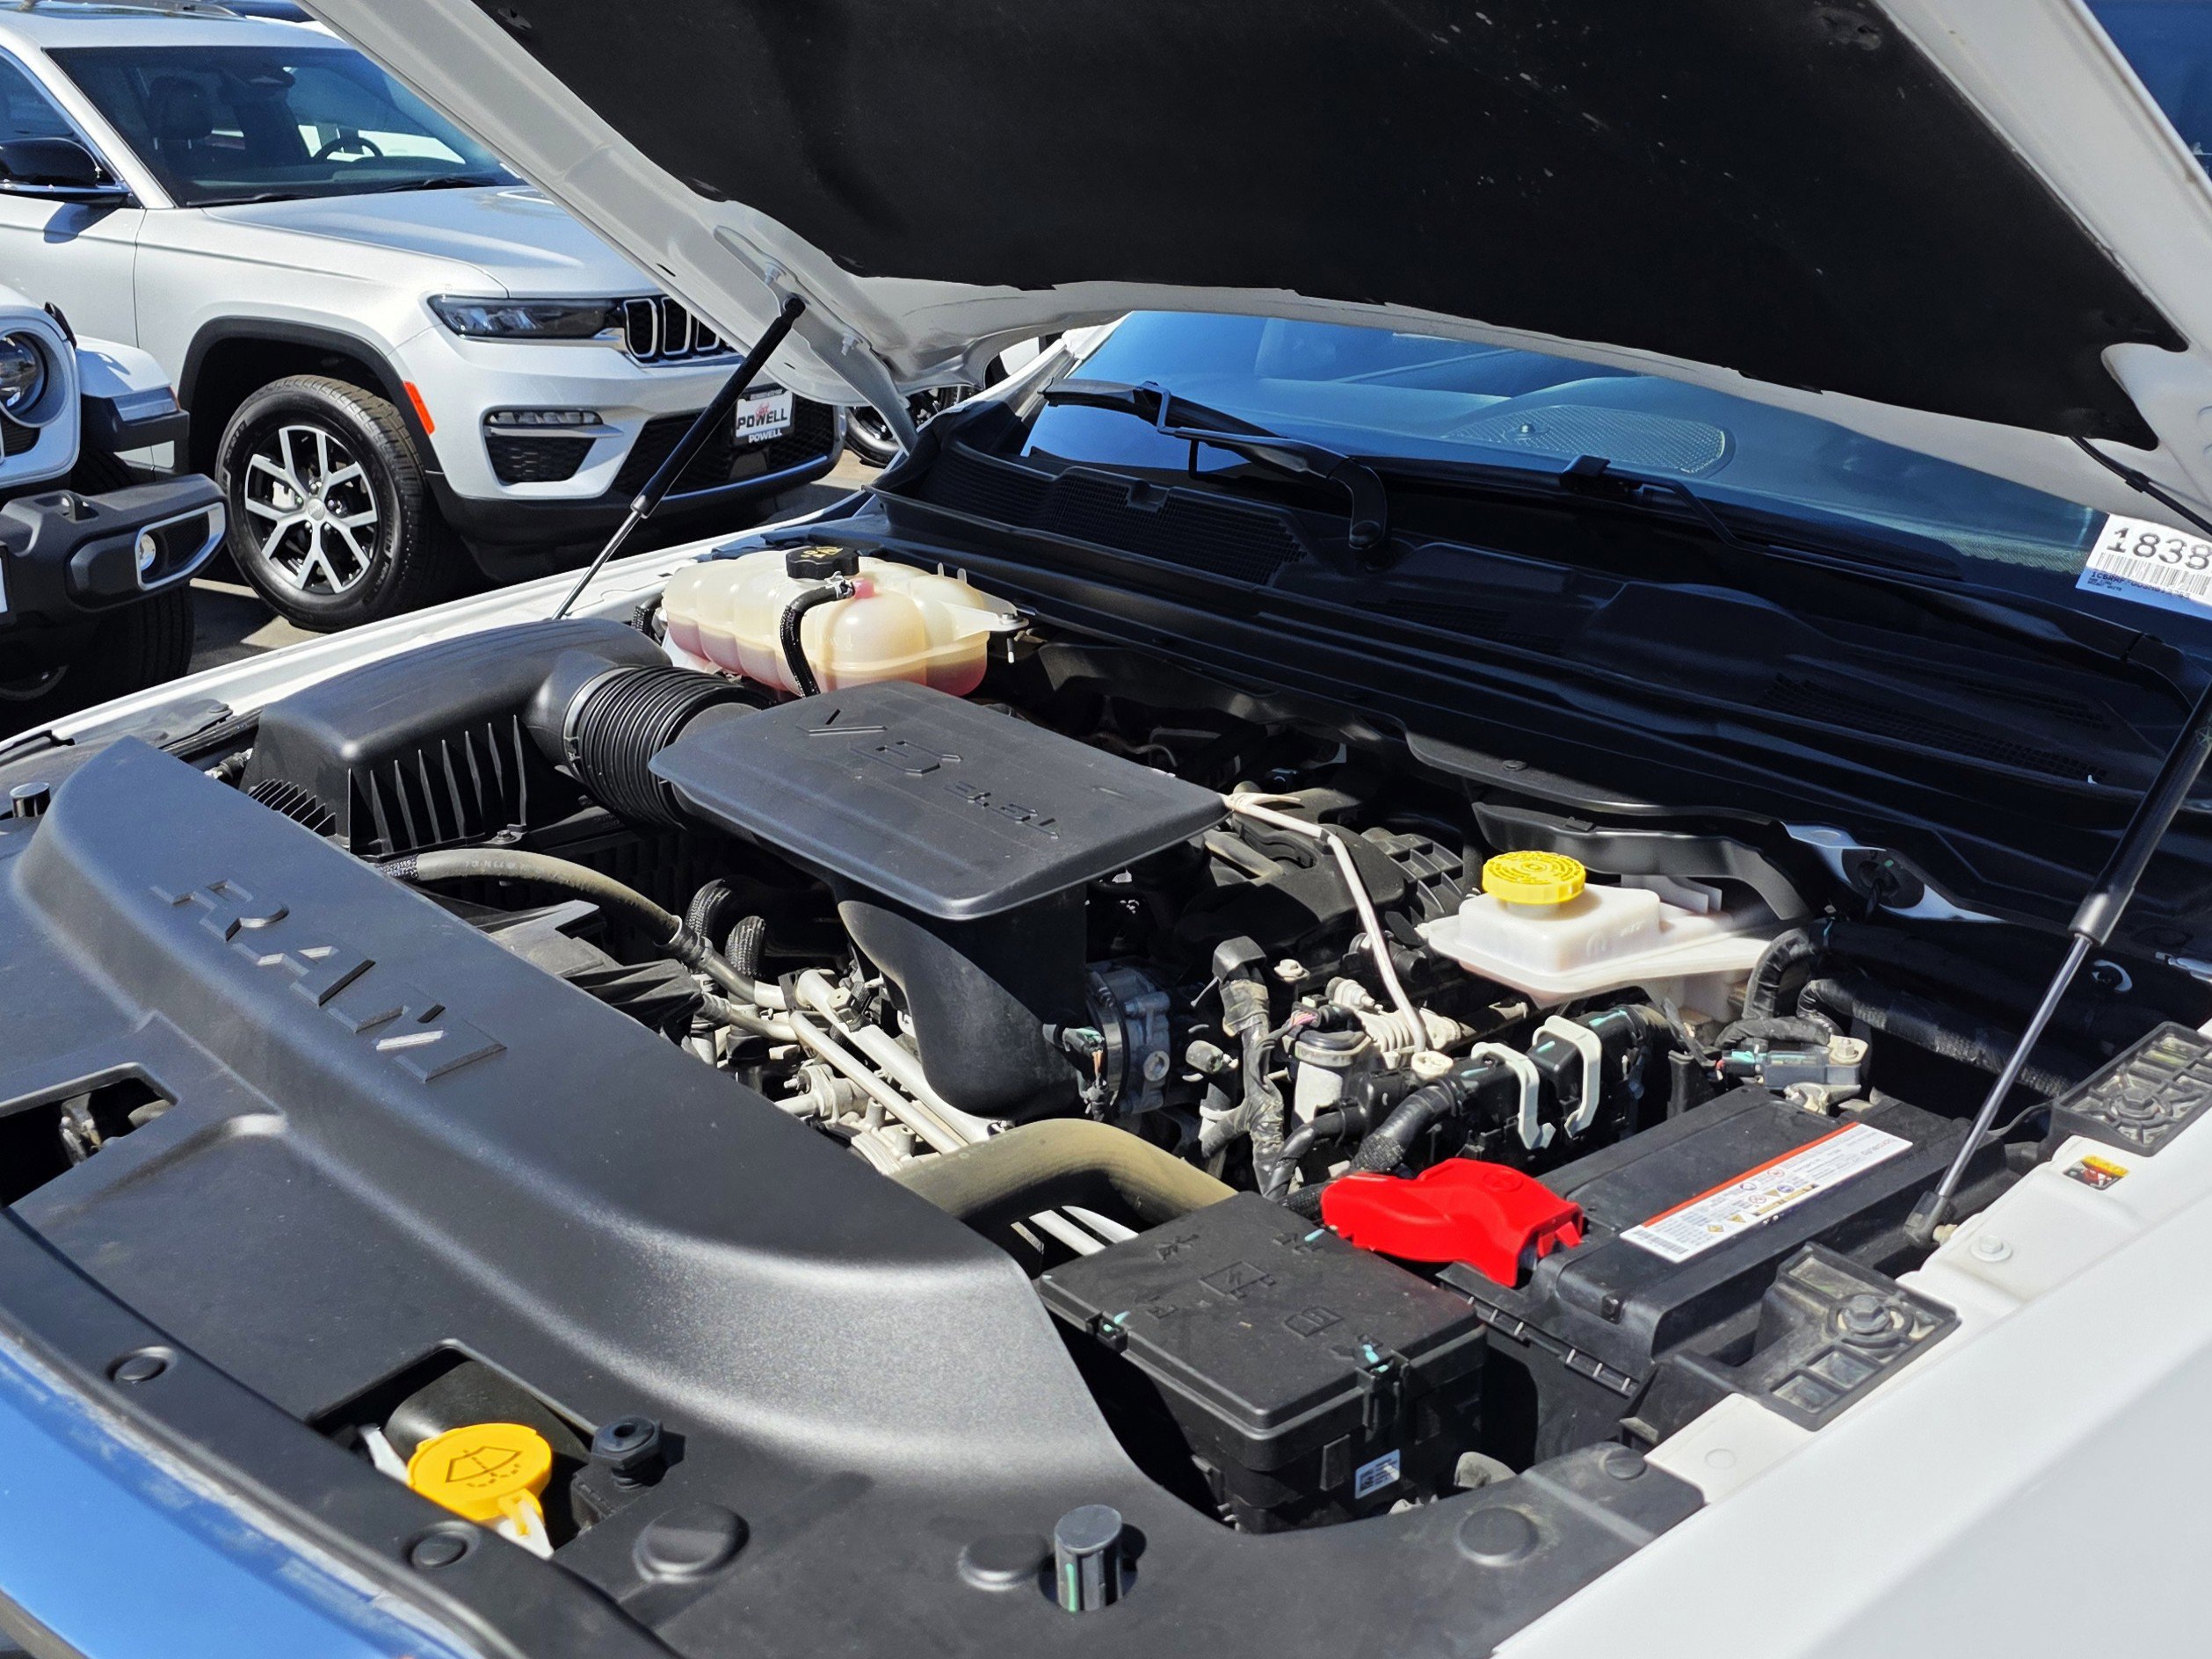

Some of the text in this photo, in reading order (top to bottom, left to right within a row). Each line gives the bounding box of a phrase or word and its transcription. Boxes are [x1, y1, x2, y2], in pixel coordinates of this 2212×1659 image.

[736, 408, 788, 431] POWELL
[748, 427, 783, 444] POWELL
[148, 877, 509, 1084] RAM
